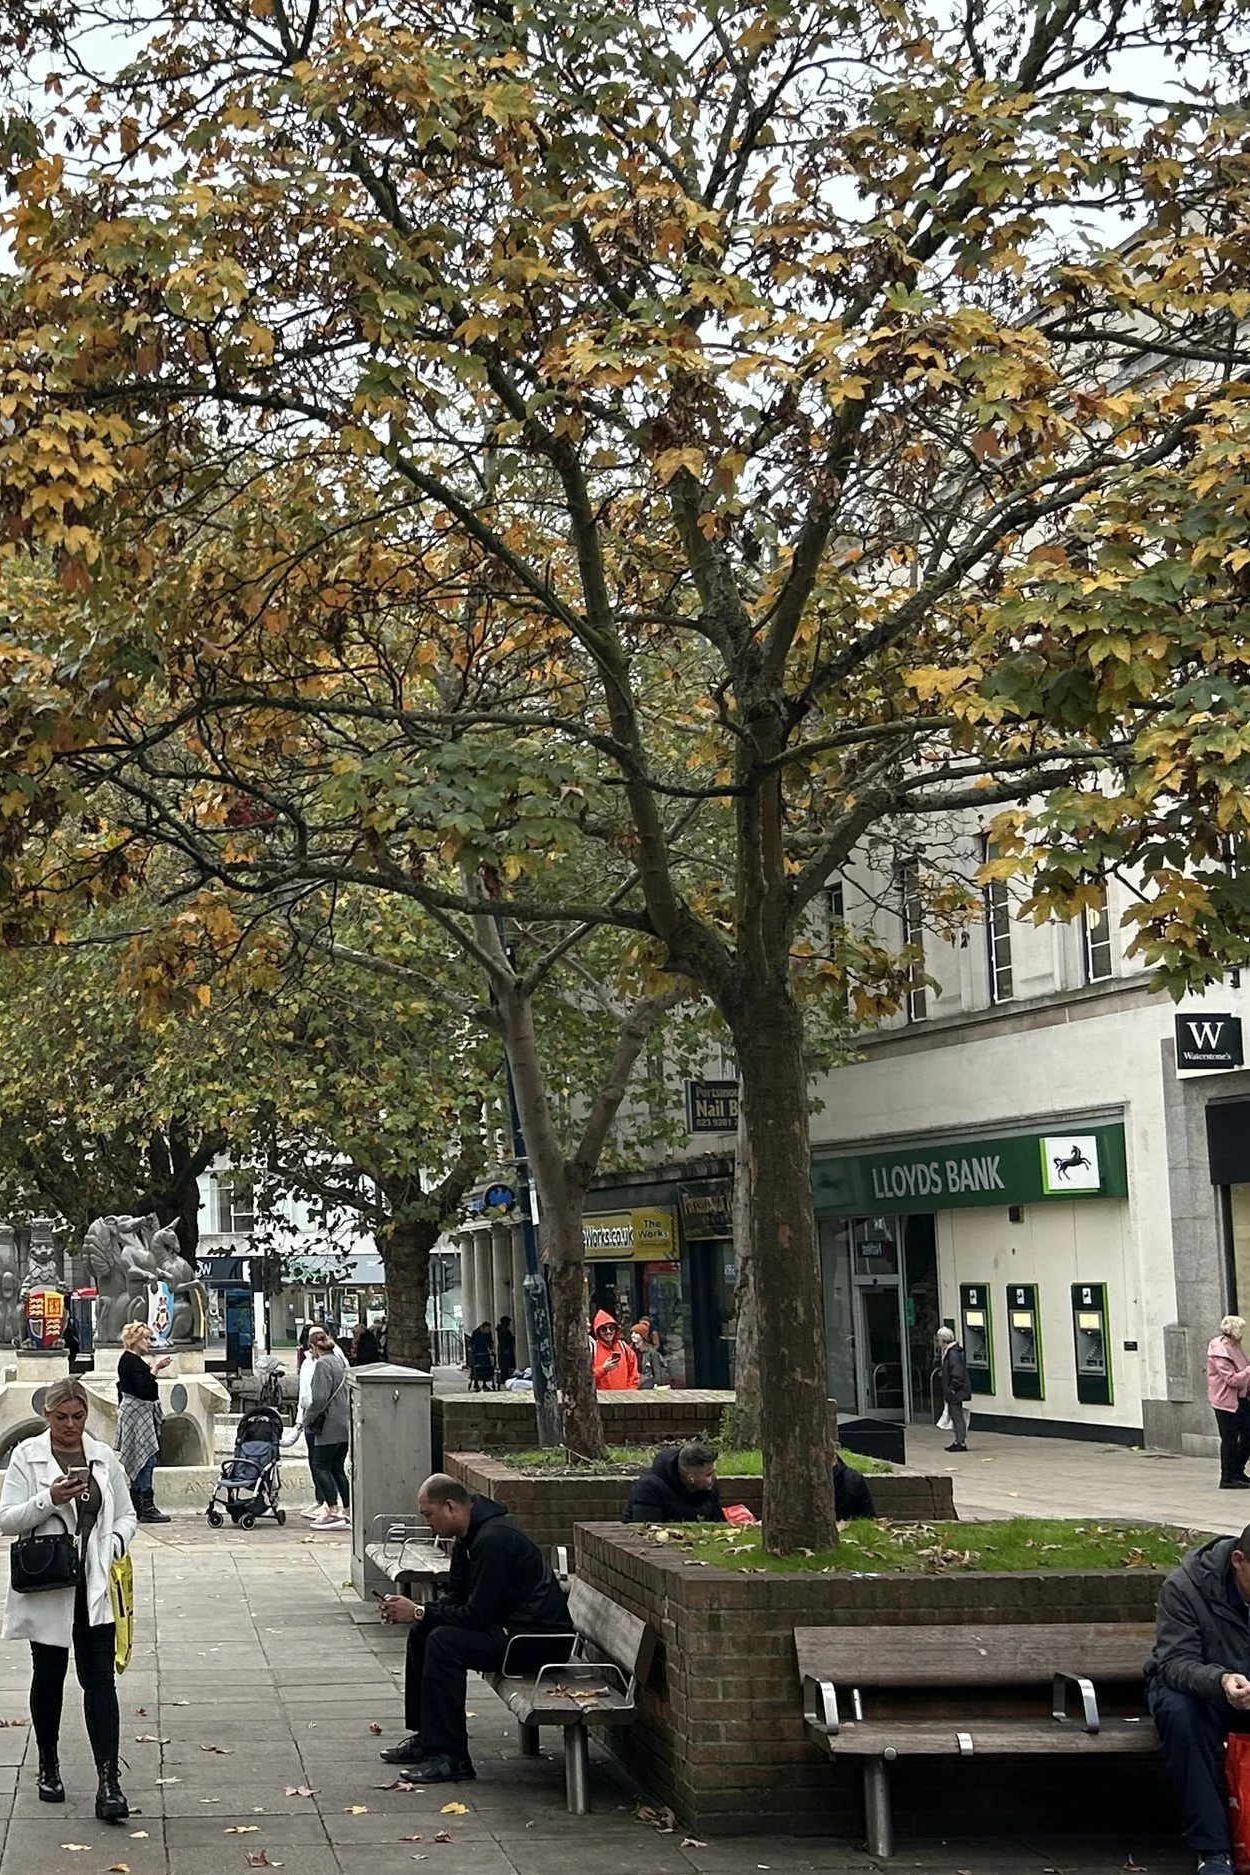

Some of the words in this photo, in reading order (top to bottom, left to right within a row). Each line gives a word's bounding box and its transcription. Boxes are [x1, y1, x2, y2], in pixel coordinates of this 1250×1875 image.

[1186, 1022, 1224, 1049] W
[695, 1086, 738, 1098] Portsmou
[695, 1100, 725, 1117] Nail
[872, 1162, 943, 1198] LLOYDS
[945, 1155, 1006, 1193] BANK
[643, 1219, 662, 1229] The
[638, 1229, 669, 1239] Works
